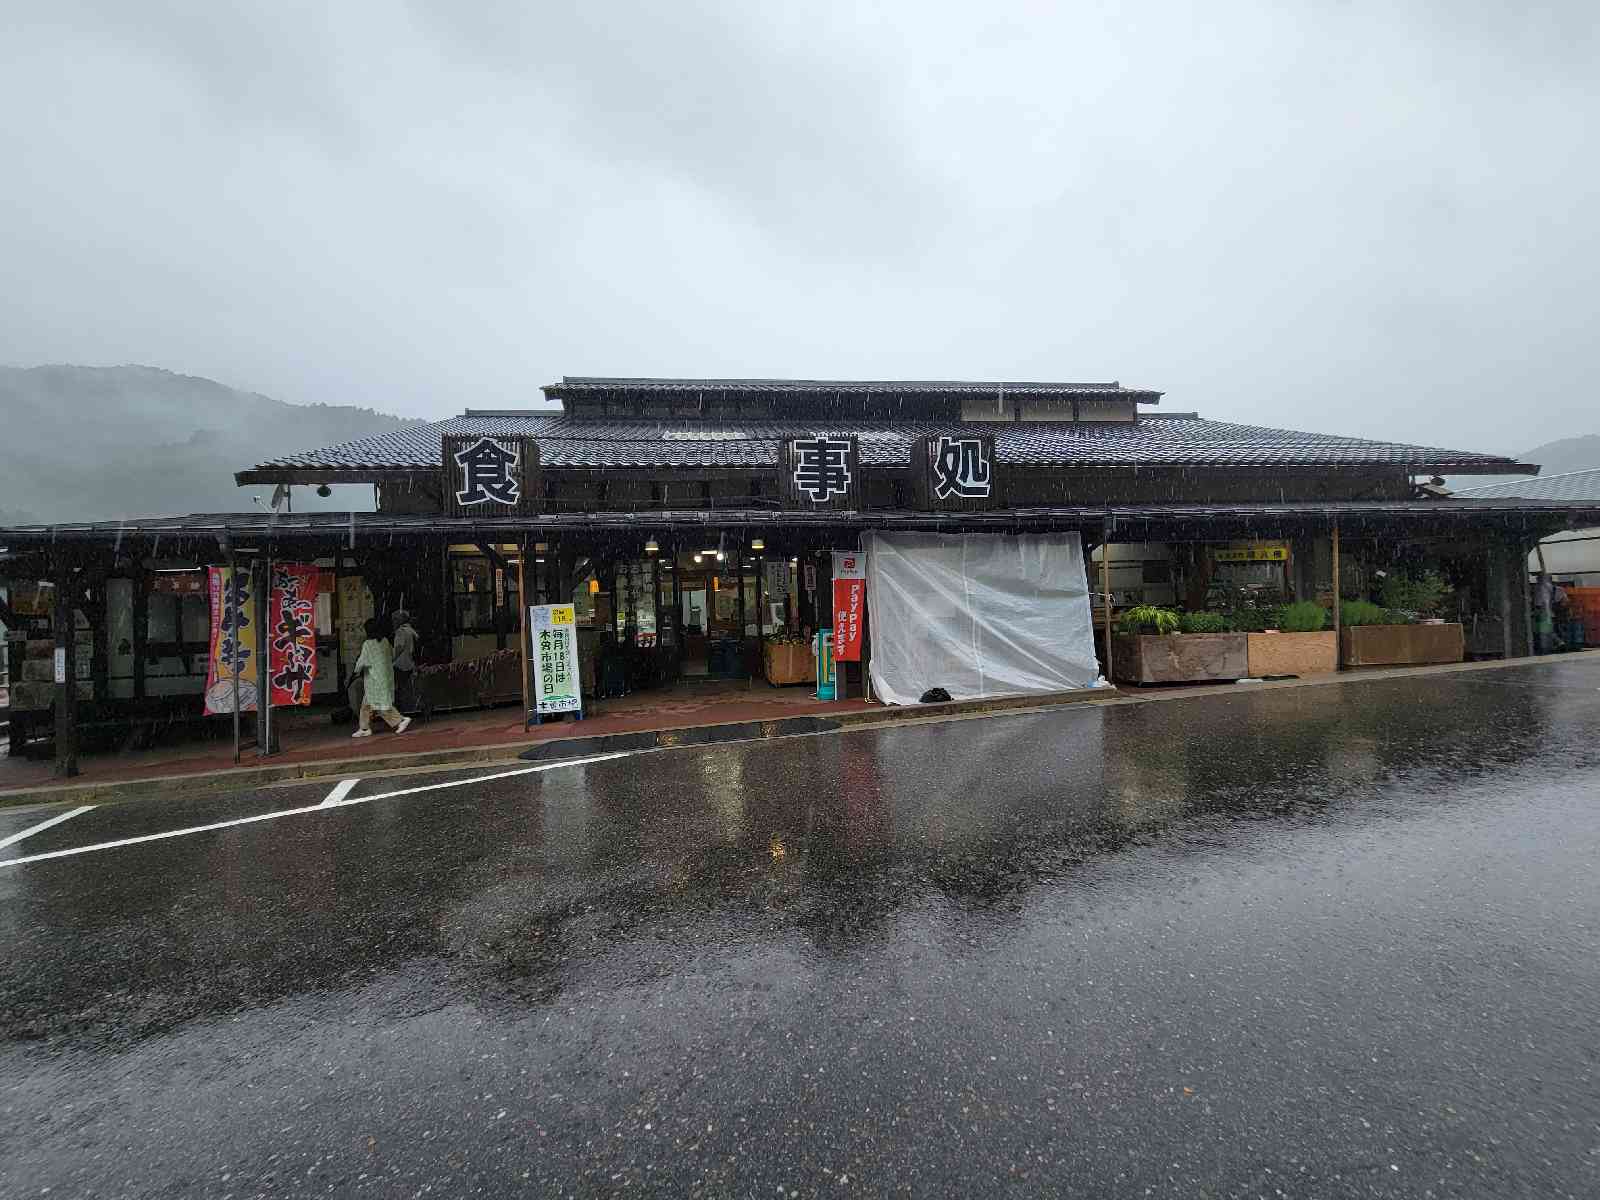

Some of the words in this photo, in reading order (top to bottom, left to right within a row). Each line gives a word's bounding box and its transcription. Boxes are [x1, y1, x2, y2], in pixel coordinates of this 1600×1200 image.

[454, 437, 520, 505] 食
[793, 436, 851, 502] 事
[934, 436, 990, 499] 処
[838, 610, 847, 656] 使えます
[849, 584, 860, 642] PayPay
[552, 629, 567, 684] 毎月18日は
